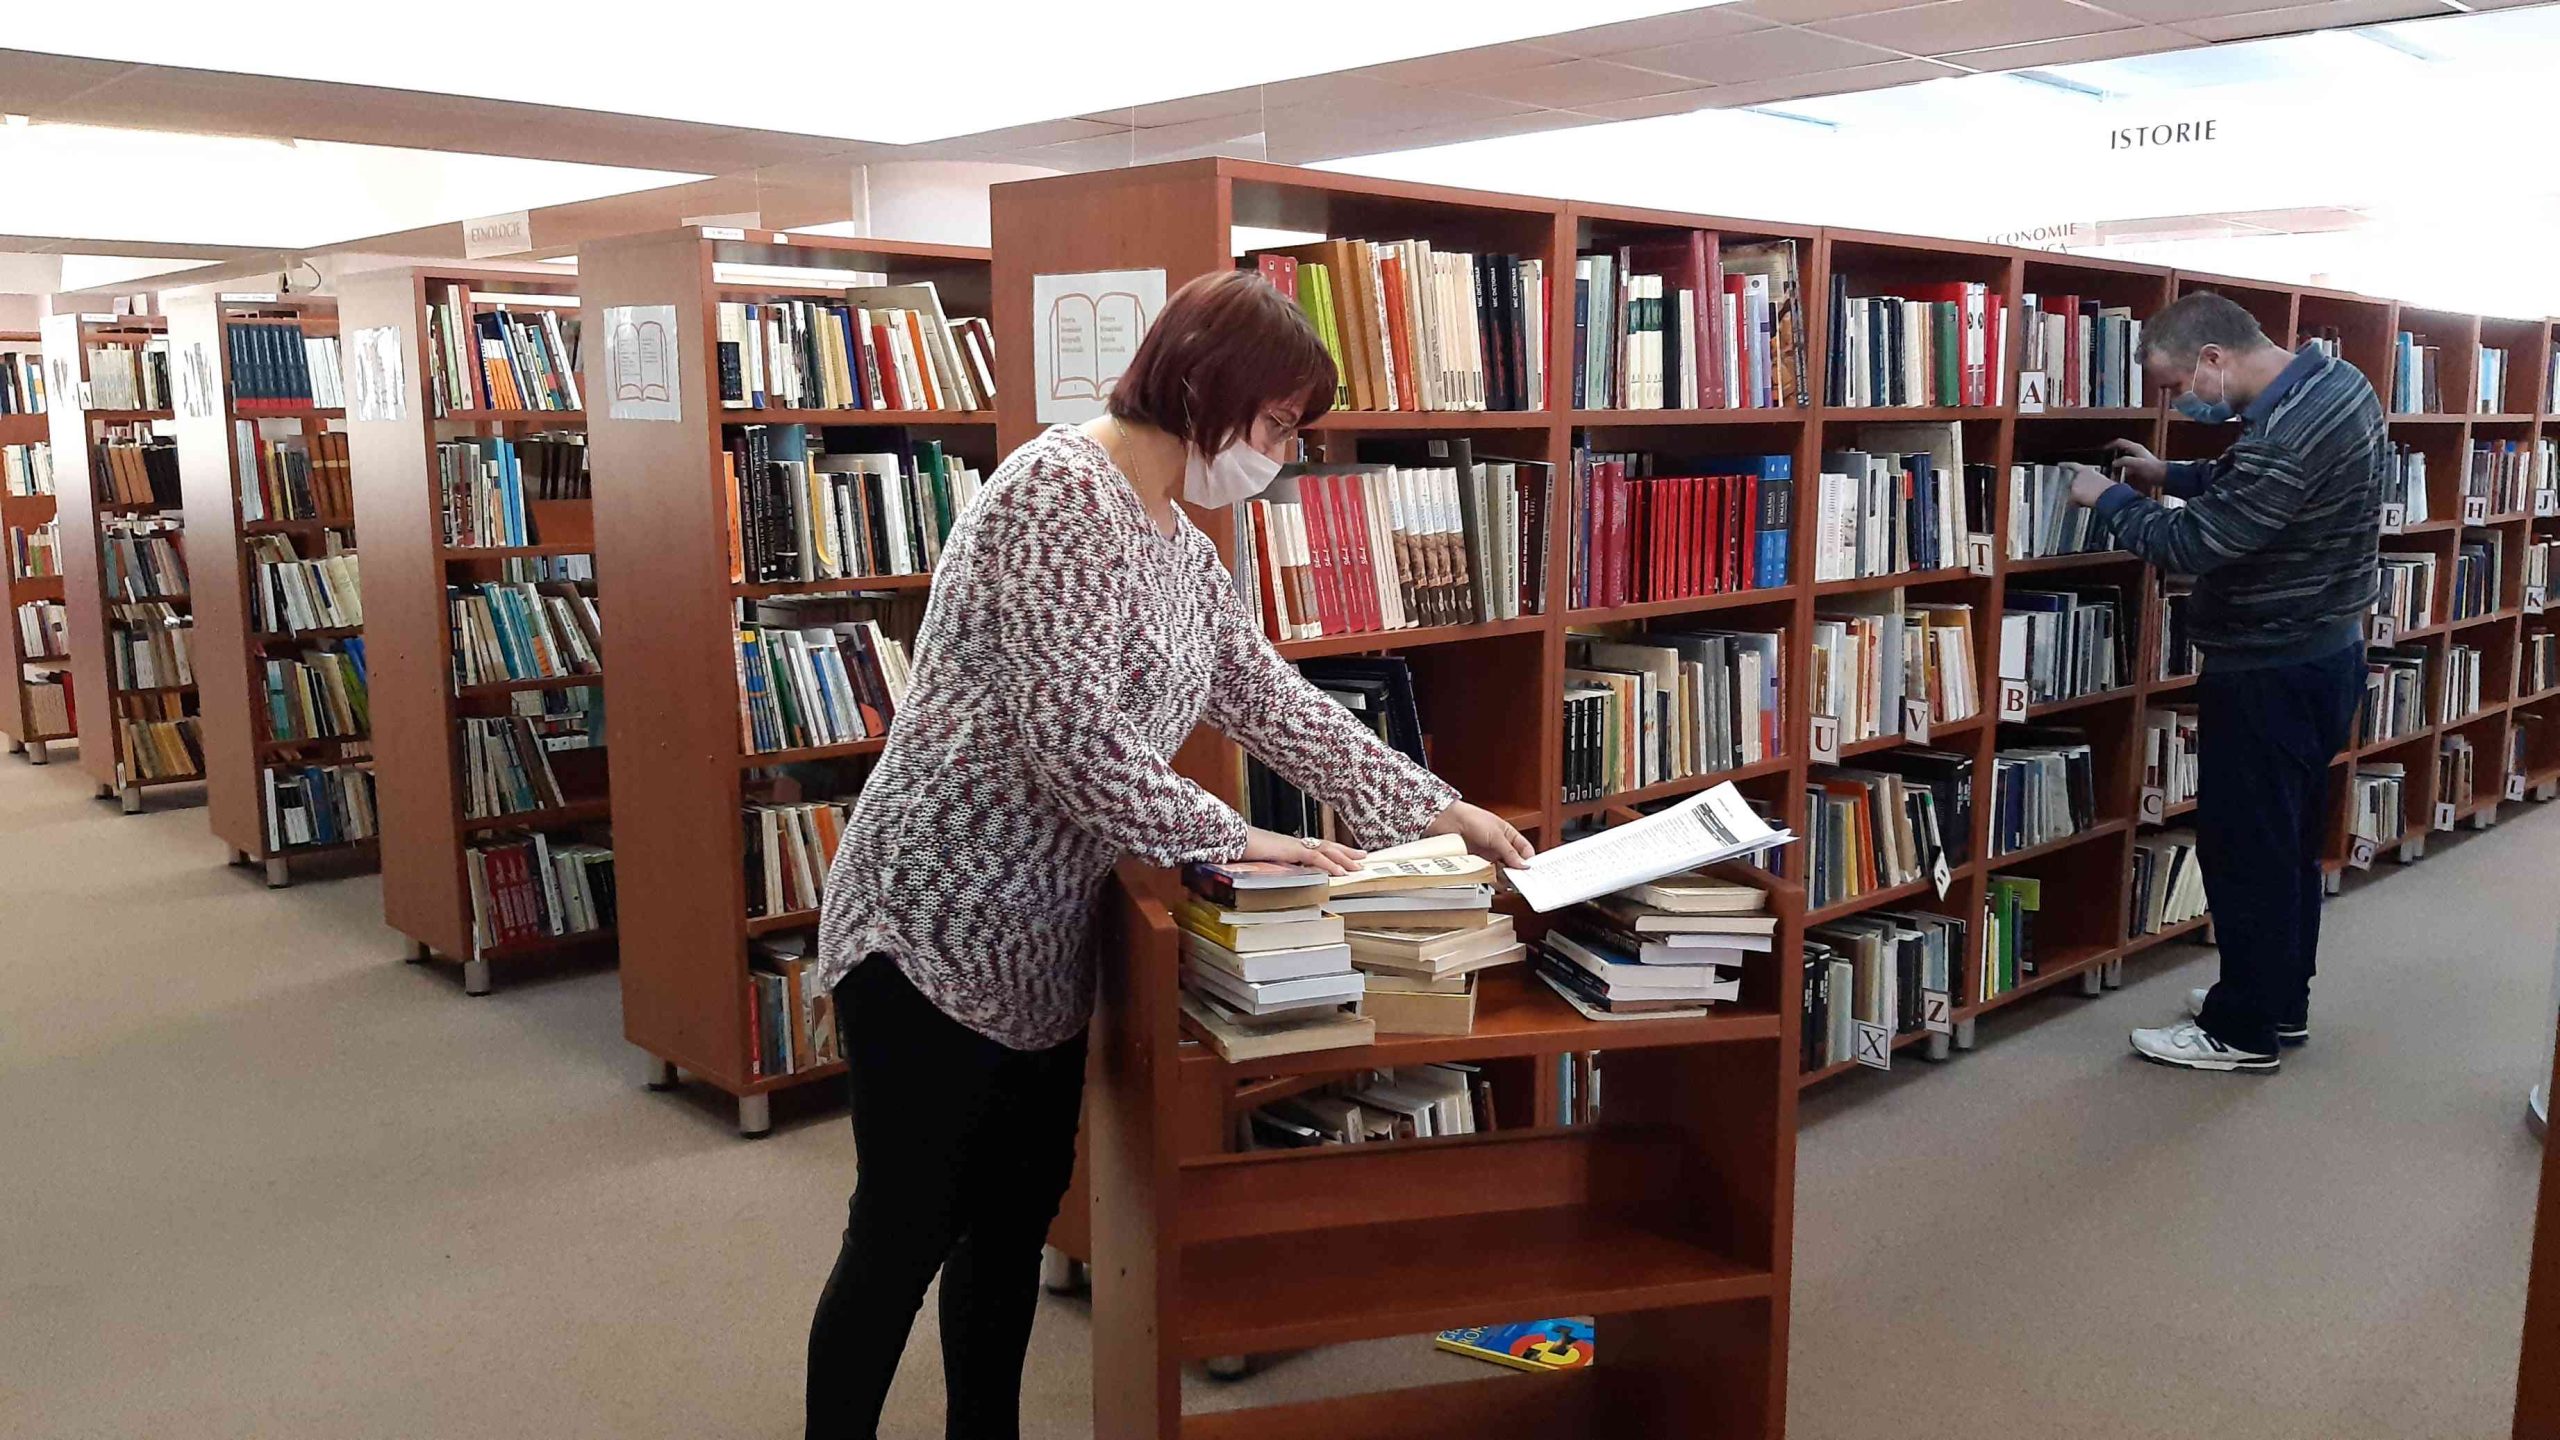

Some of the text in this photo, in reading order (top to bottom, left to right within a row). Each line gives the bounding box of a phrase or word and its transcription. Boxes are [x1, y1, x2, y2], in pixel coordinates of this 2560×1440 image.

[2110, 119, 2217, 150] ISTORIE
[2022, 379, 2042, 404] A
[2468, 502, 2483, 519] H
[2538, 494, 2549, 510] J
[2385, 509, 2400, 527] E
[2527, 591, 2542, 607] K
[2377, 622, 2392, 640] F
[2004, 688, 2024, 711] B
[1906, 707, 1926, 732] V
[1814, 726, 1834, 752] U
[2143, 793, 2162, 816] C
[2353, 845, 2373, 863] G
[1927, 999, 1947, 1024] Z
[1861, 1029, 1885, 1060] X
